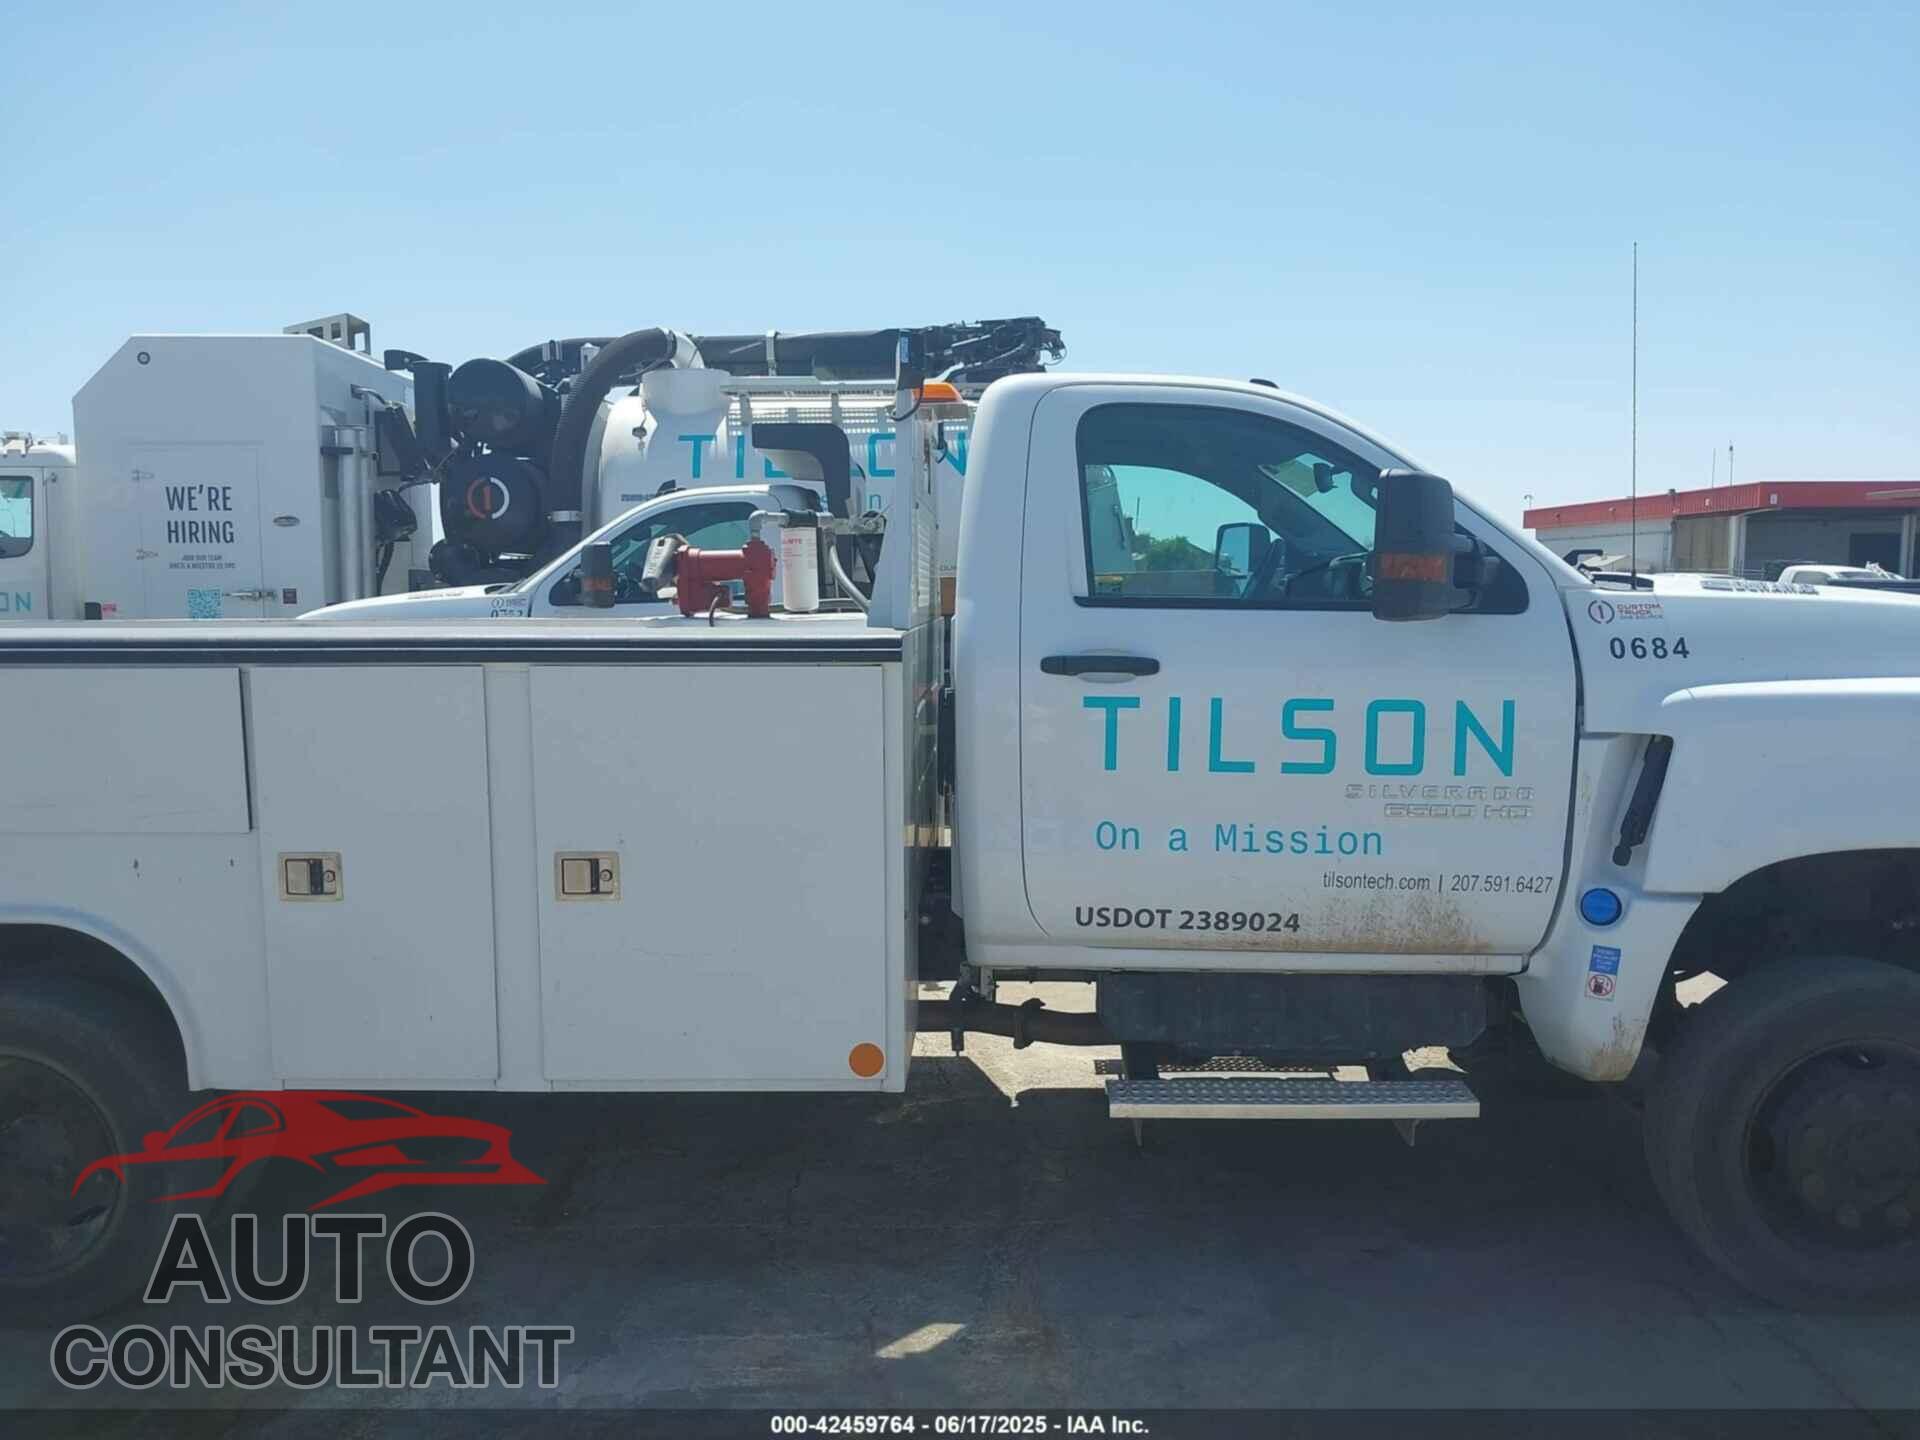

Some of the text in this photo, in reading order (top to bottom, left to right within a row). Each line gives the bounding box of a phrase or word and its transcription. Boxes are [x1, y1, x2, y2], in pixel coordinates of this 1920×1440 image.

[165, 484, 233, 511] WE'RE
[167, 520, 234, 544] HIRING
[1609, 637, 1690, 659] 0684
[1083, 696, 1516, 777] TILSON
[1344, 783, 1535, 800] SILVERADO
[1483, 804, 1534, 819] HD
[1096, 821, 1382, 856] On a Mission
[1323, 871, 1430, 892] tilsontech.com
[1451, 874, 1553, 894] 207.591.6427
[1075, 906, 1300, 933] USDOT 2389024
